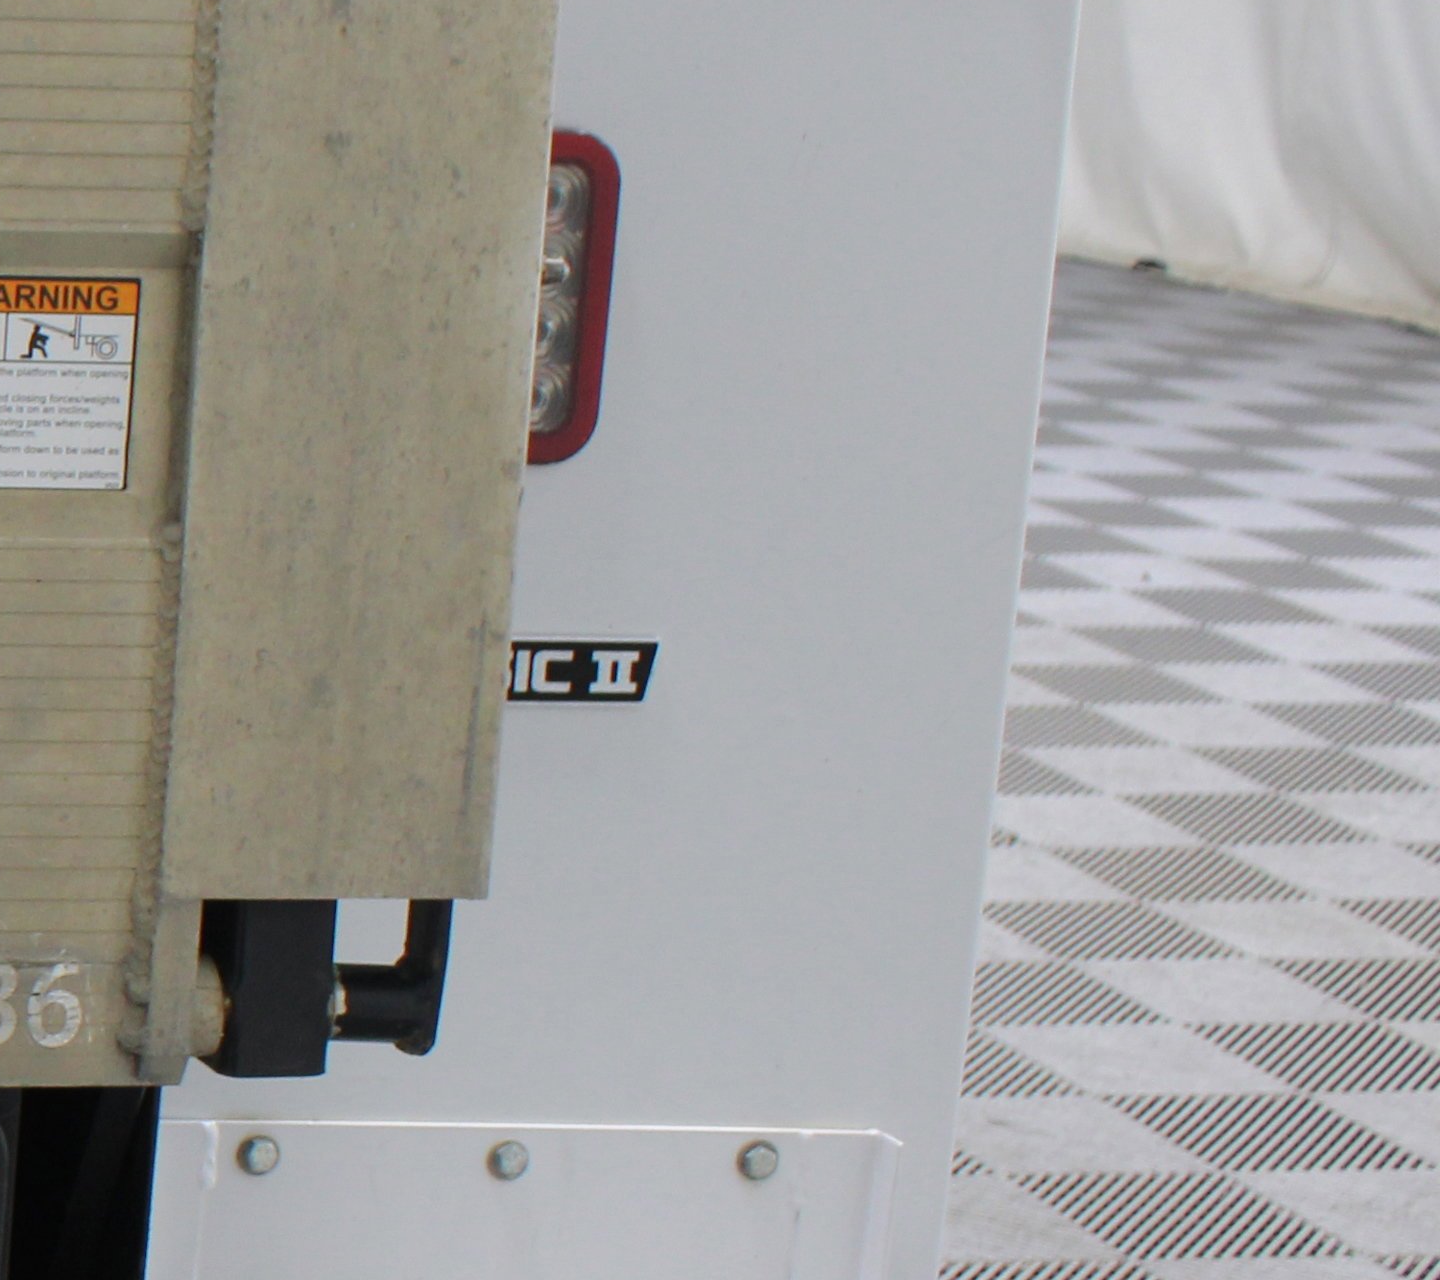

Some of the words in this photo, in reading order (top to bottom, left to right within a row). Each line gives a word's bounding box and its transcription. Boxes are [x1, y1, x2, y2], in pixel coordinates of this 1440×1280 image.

[16, 368, 58, 377] platform
[61, 369, 87, 377] when
[89, 370, 129, 380] opening
[11, 394, 47, 404] closing
[23, 445, 50, 454] down
[53, 446, 63, 454] to
[65, 446, 78, 455] be
[80, 446, 106, 455] used
[108, 447, 120, 455] as
[39, 469, 77, 480] original
[511, 648, 575, 694] IC
[588, 650, 641, 694] II
